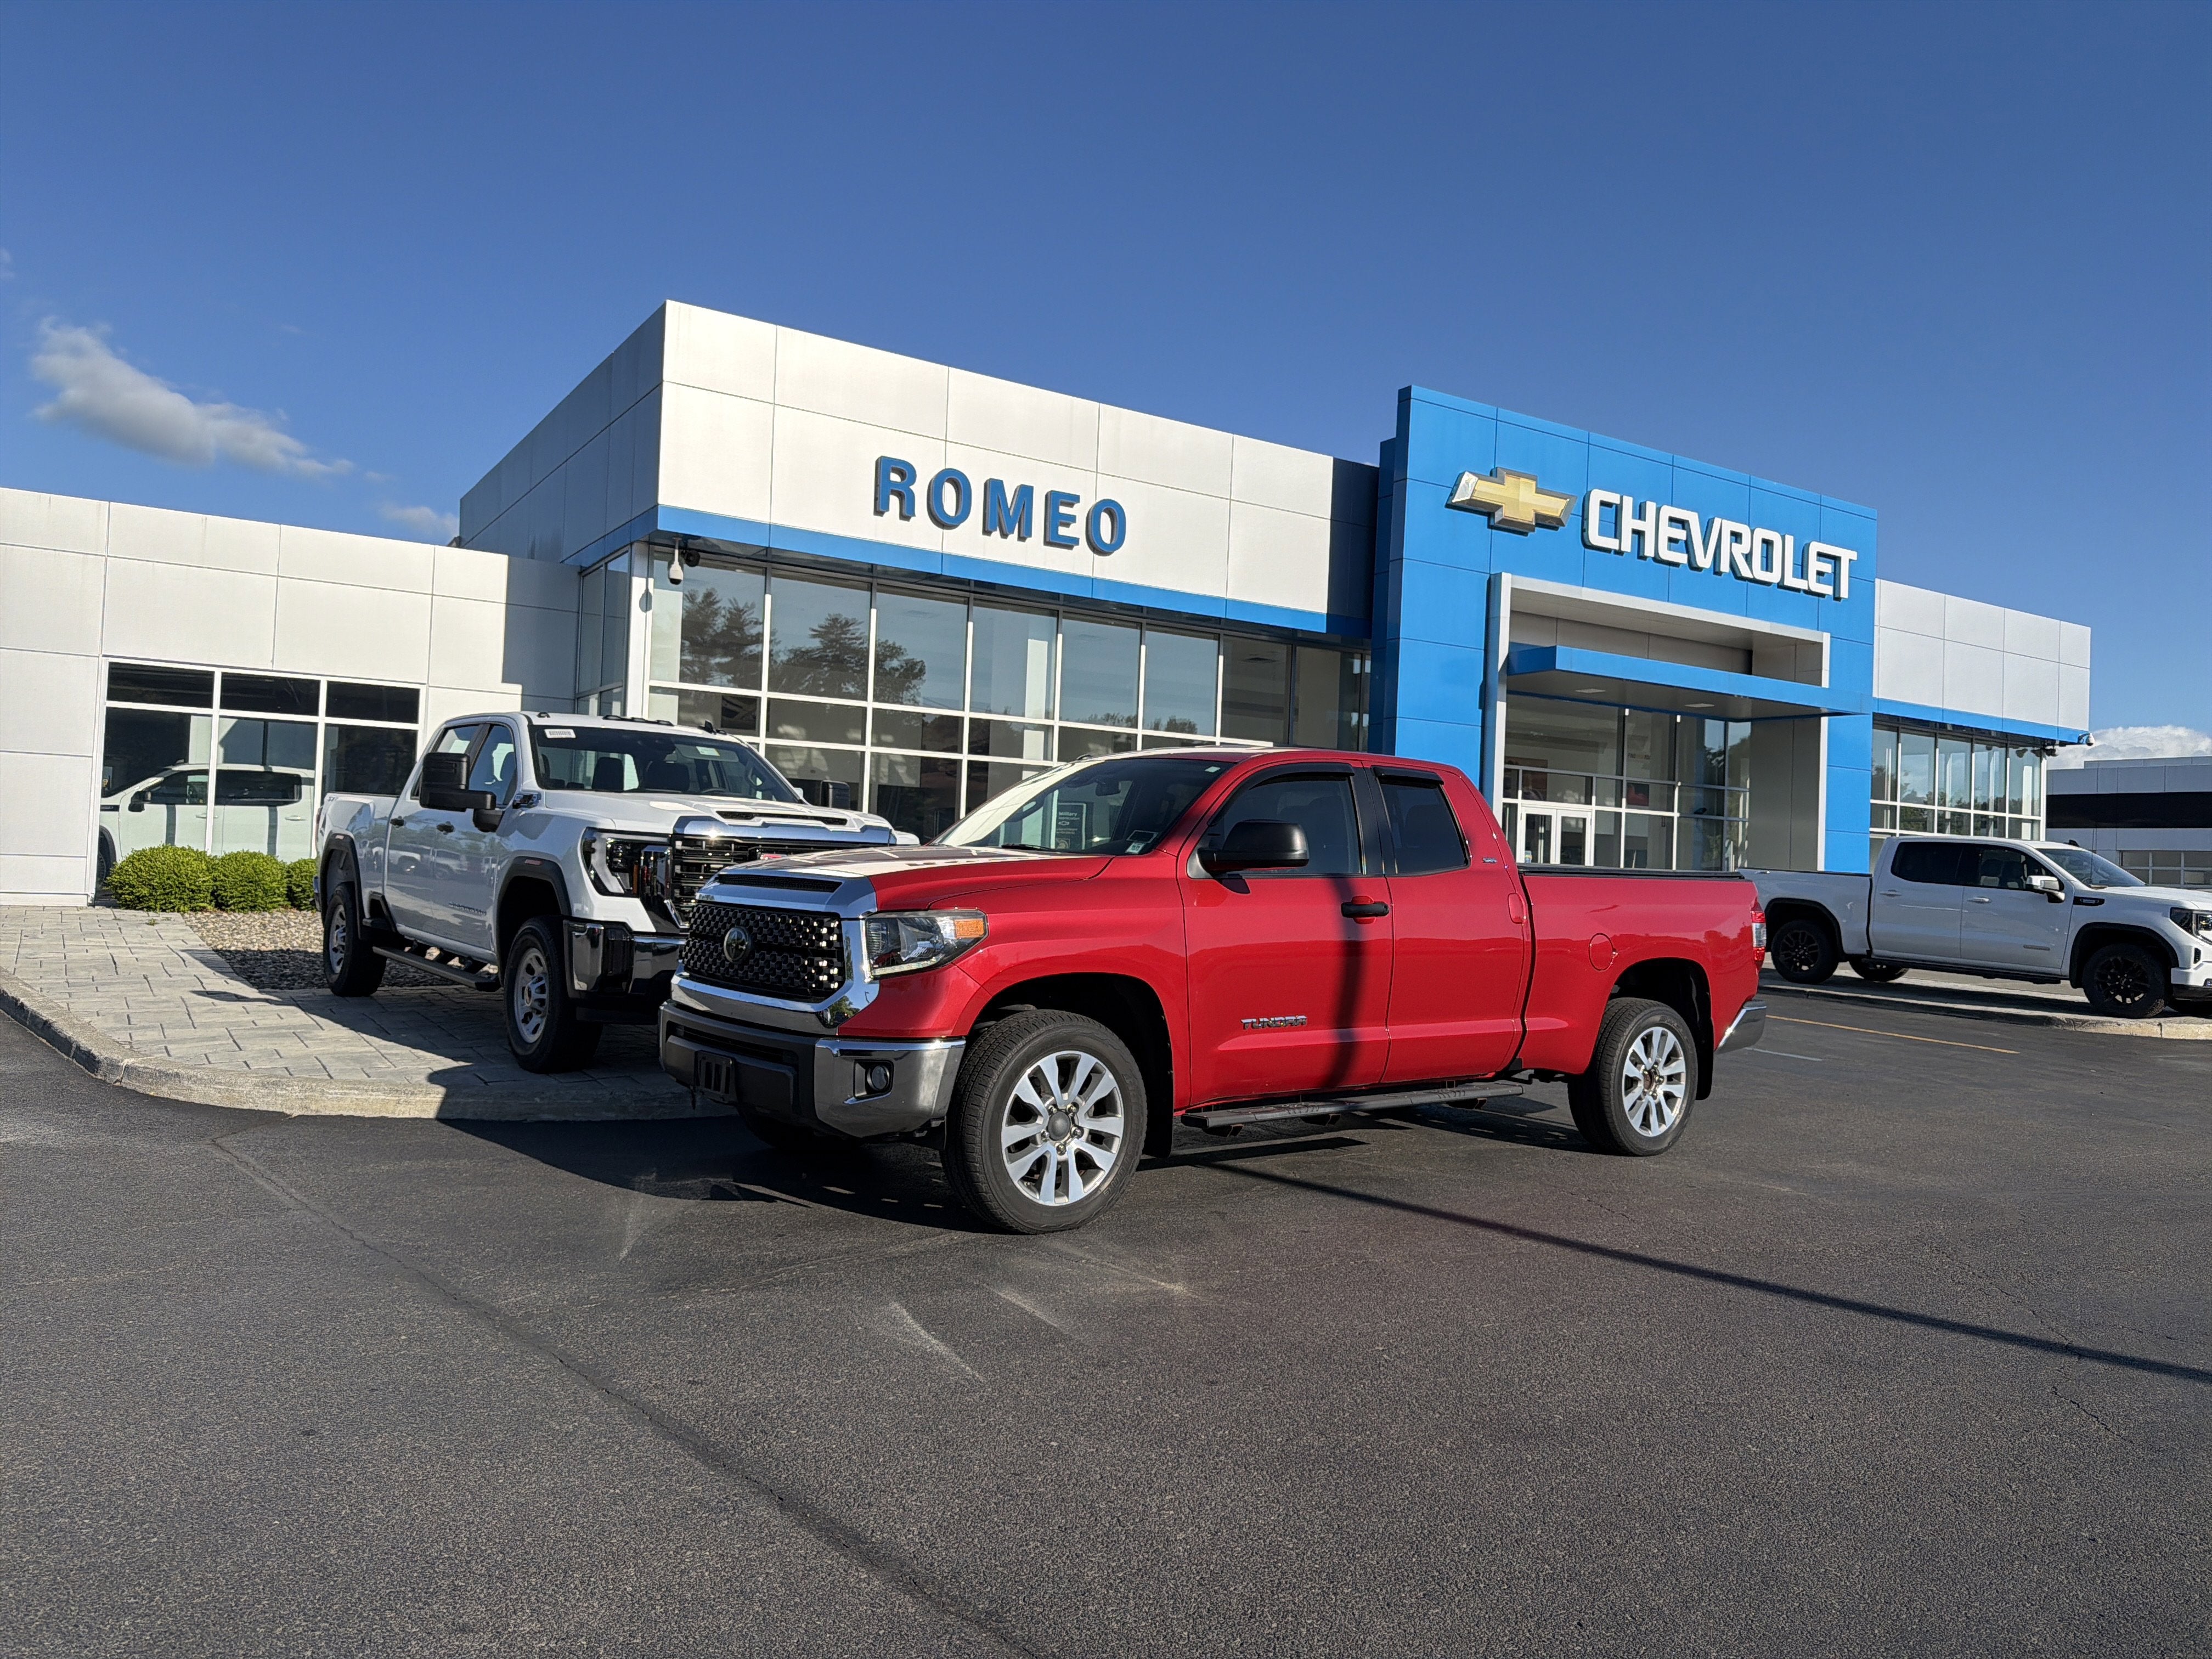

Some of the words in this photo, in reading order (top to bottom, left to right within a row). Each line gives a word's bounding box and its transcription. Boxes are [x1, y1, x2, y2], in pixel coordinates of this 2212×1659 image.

[873, 456, 1126, 556] ROMEO
[1582, 489, 1858, 600] CHEVROLET
[1240, 1015, 1307, 1030] TUNDRA
